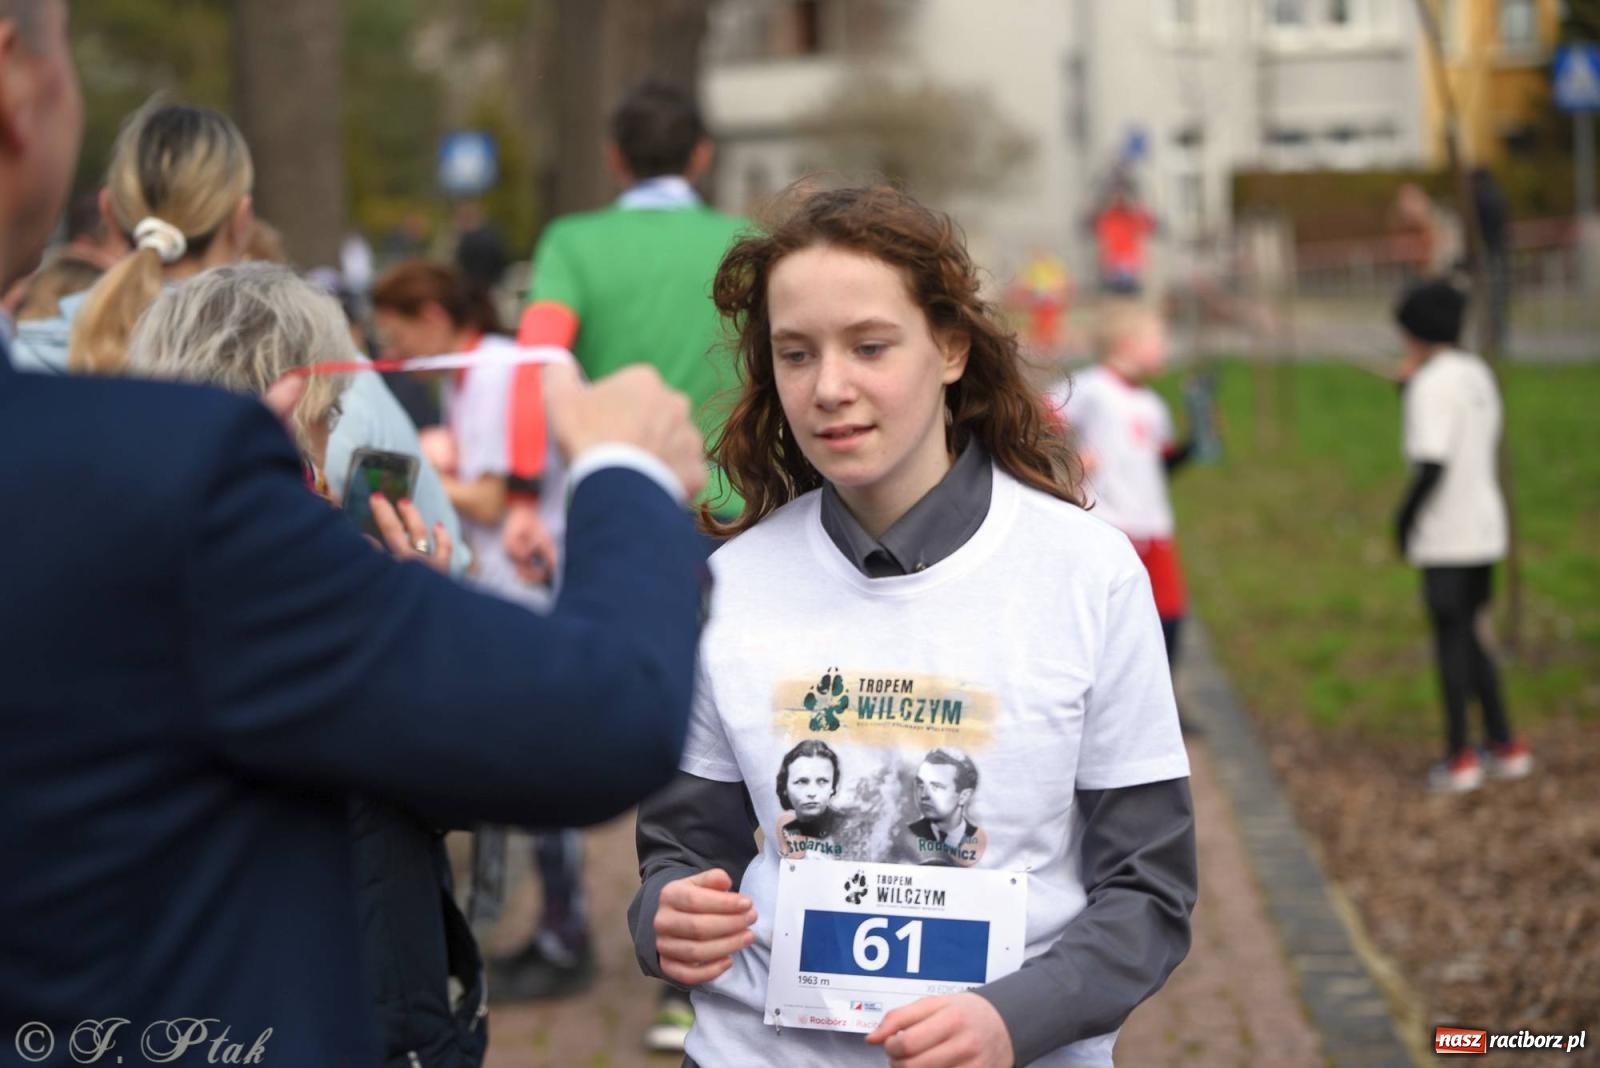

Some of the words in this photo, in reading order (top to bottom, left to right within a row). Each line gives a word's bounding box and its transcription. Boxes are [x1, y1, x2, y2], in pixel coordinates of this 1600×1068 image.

[859, 678, 914, 694] TROPEM
[858, 696, 962, 725] WILCZYM
[876, 874, 913, 886] TROPEM
[877, 887, 946, 906] WILCZYM
[853, 917, 923, 974] 61
[798, 975, 818, 986] 1963
[820, 977, 830, 986] m
